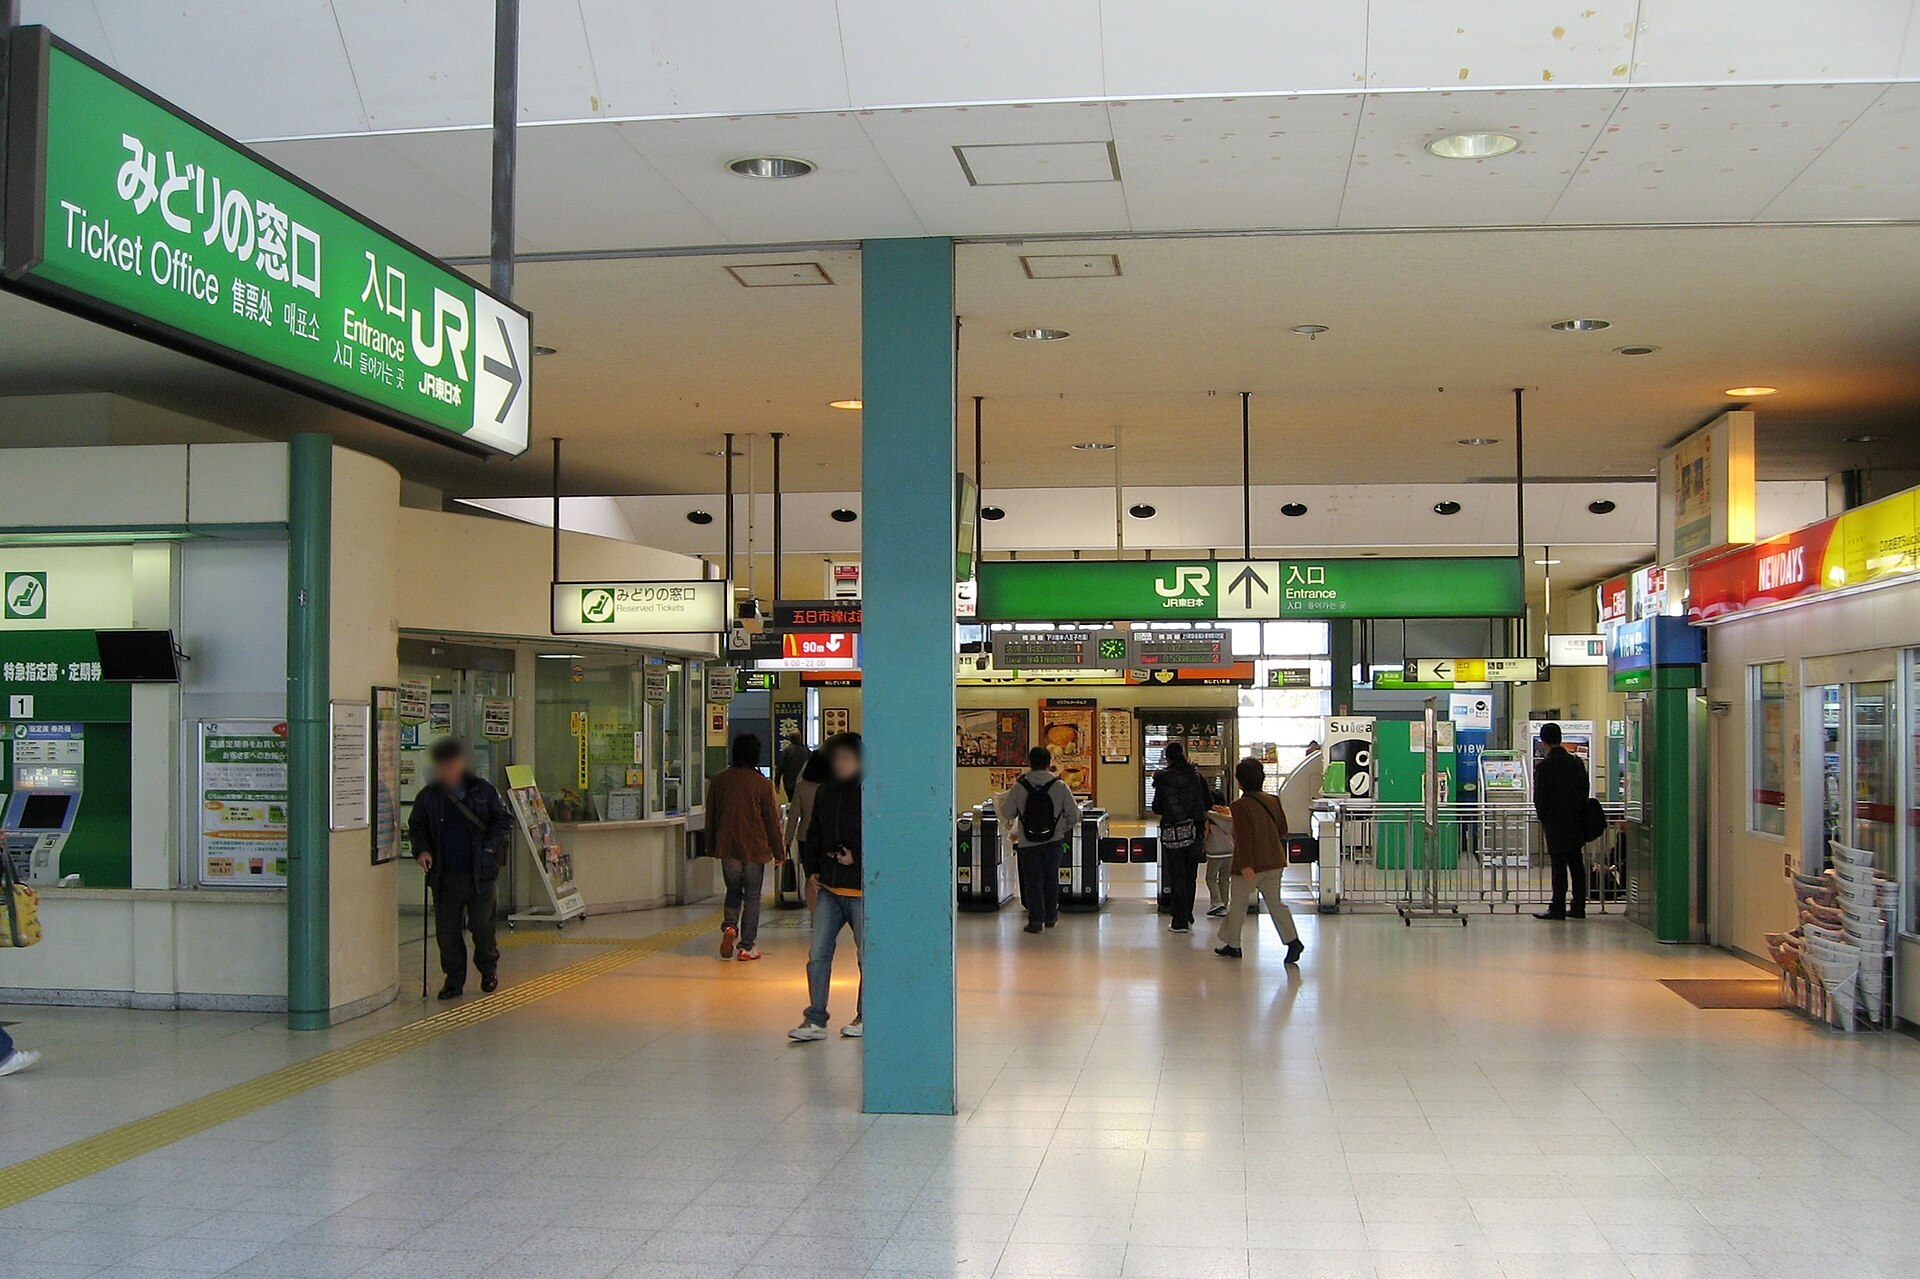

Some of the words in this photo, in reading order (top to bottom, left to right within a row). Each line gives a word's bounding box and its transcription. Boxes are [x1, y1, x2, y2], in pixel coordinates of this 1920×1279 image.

[116, 133, 321, 299] みどりの窓口
[60, 200, 143, 276] Ticket
[150, 241, 219, 305] Office
[361, 250, 406, 323] 入口
[231, 277, 273, 327] 售票处
[283, 302, 320, 341] 매표소
[343, 307, 405, 362] Entrance
[411, 286, 469, 382] JR
[333, 340, 353, 369] 入口
[359, 352, 393, 386] 들어가는
[396, 367, 405, 390] 곳
[418, 371, 462, 407] JR東日本
[1155, 566, 1211, 597] JR
[1286, 566, 1325, 585] 入口
[1758, 546, 1804, 591] NEWDAYS
[616, 587, 696, 601] みどりの窓口
[616, 604, 654, 612] Reserved
[657, 604, 685, 612] Tickets
[1162, 598, 1205, 608] JR東日本
[1286, 588, 1337, 600] Entrance
[1287, 601, 1302, 610] 入口
[802, 641, 825, 653] 90m
[3, 662, 102, 681] 特急指定席・定期券
[1270, 671, 1278, 682] 2
[18, 698, 24, 715] 1
[1330, 721, 1373, 733] Suica
